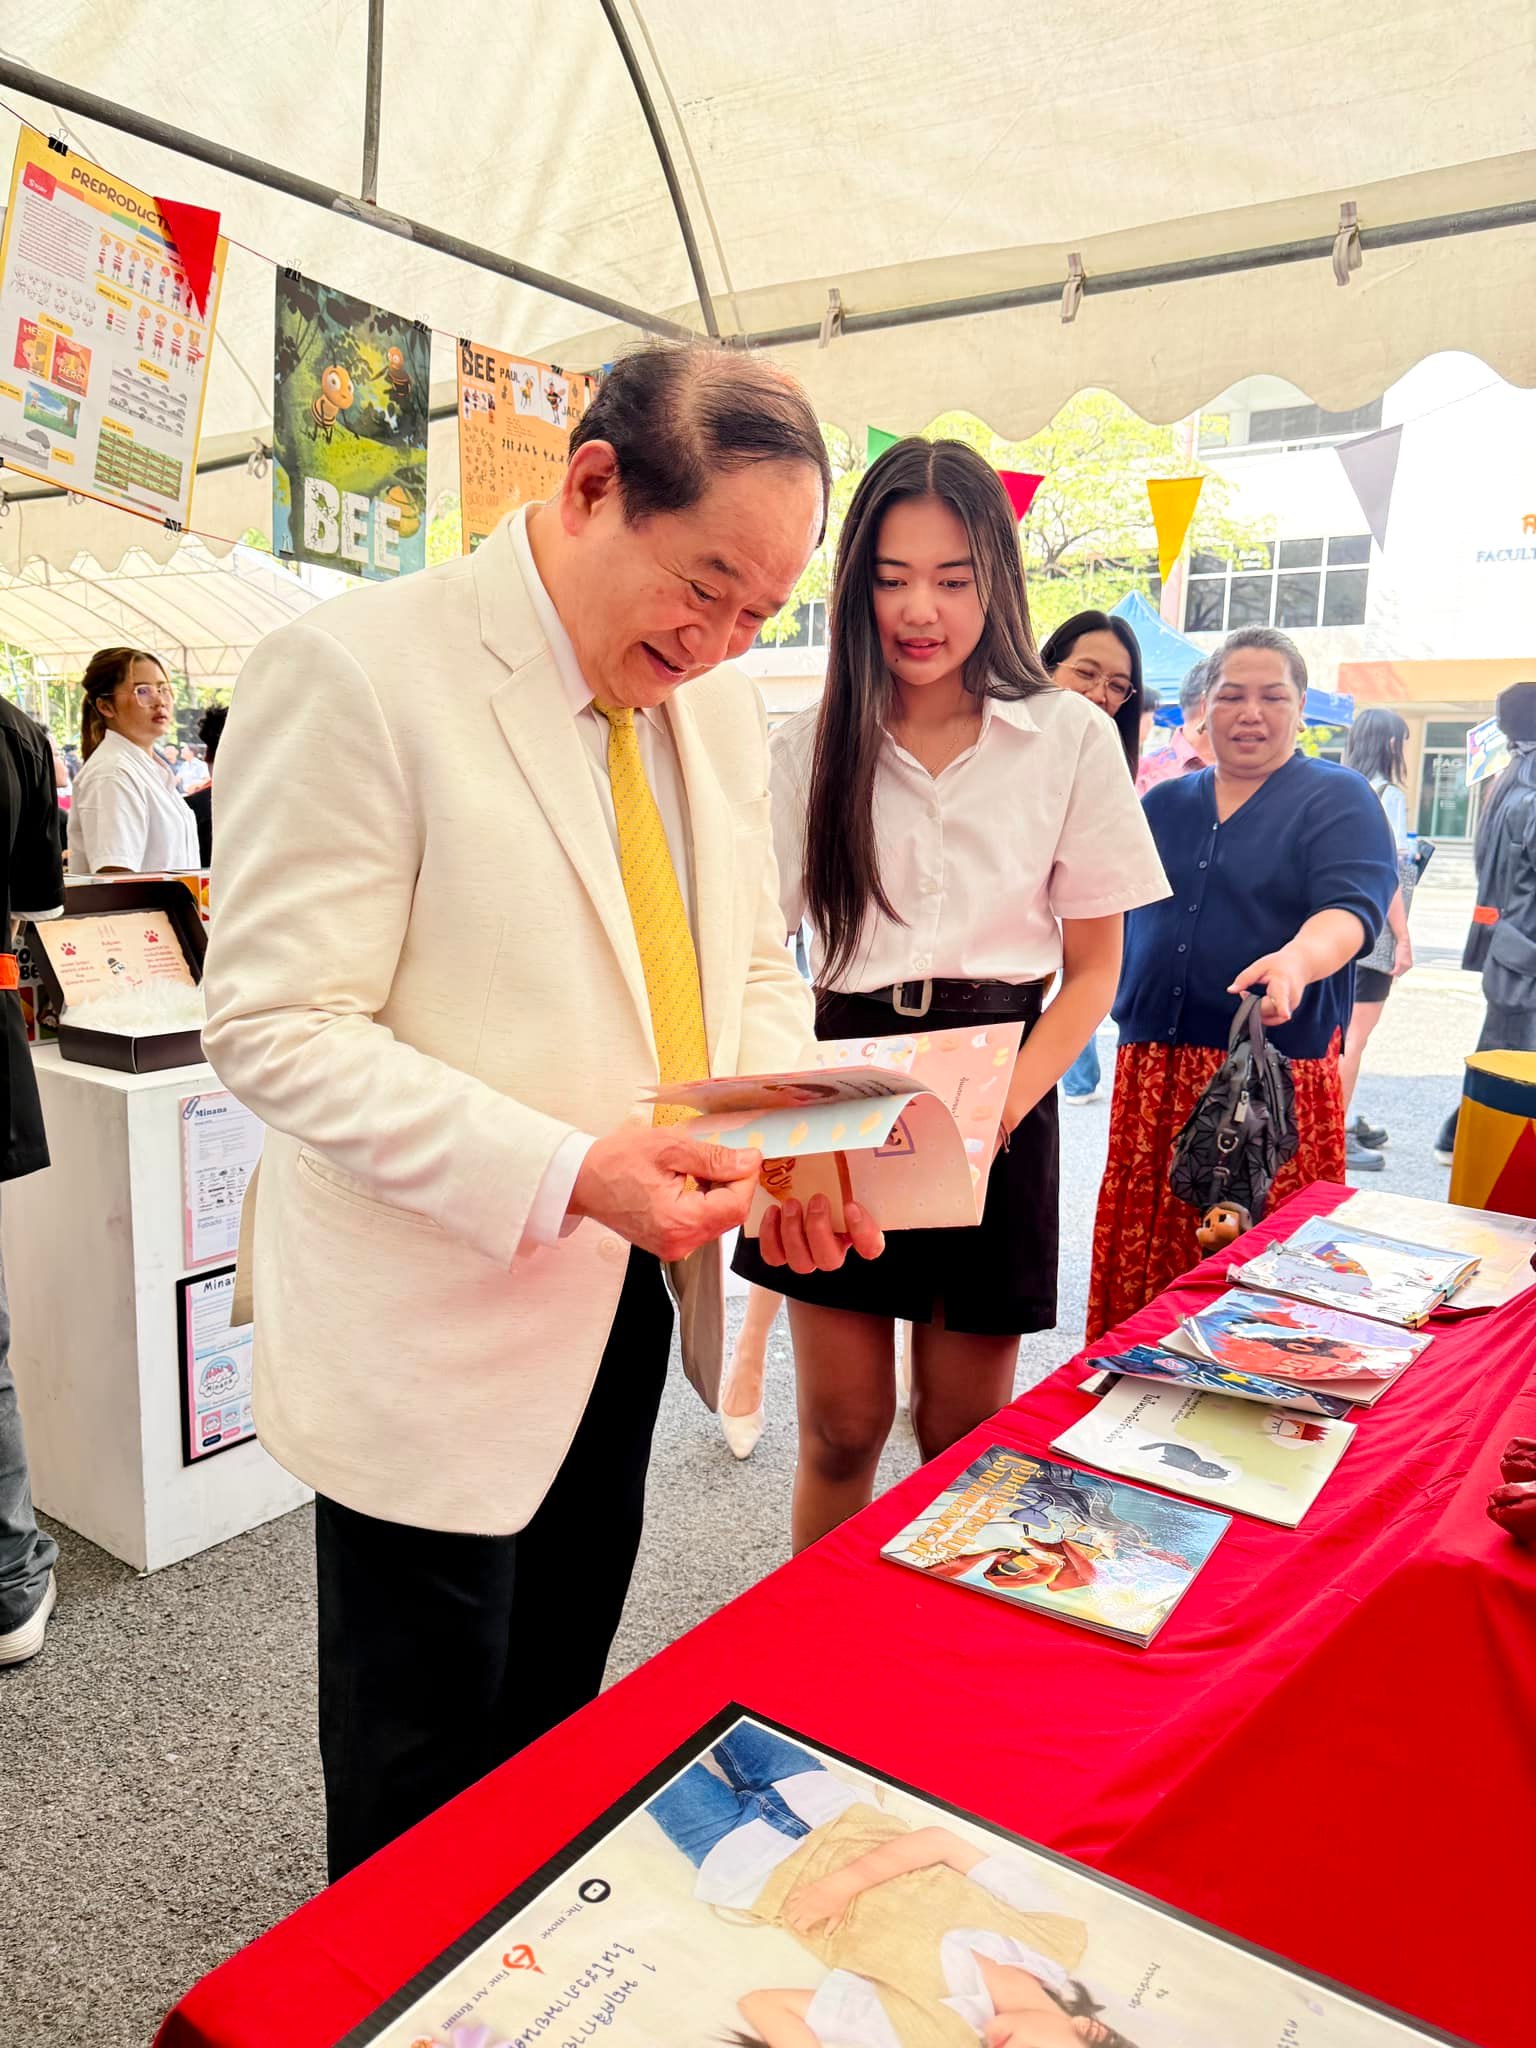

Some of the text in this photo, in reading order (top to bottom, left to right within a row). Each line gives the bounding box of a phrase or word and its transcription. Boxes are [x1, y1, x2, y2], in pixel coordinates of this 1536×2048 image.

[462, 348, 496, 384] BEE
[499, 367, 521, 384] PAUL
[304, 476, 401, 572] BEE
[195, 1107, 227, 1117] Minana
[540, 1903, 585, 1940] The movie
[489, 1968, 511, 1988] Fine
[473, 1987, 490, 2003] Art
